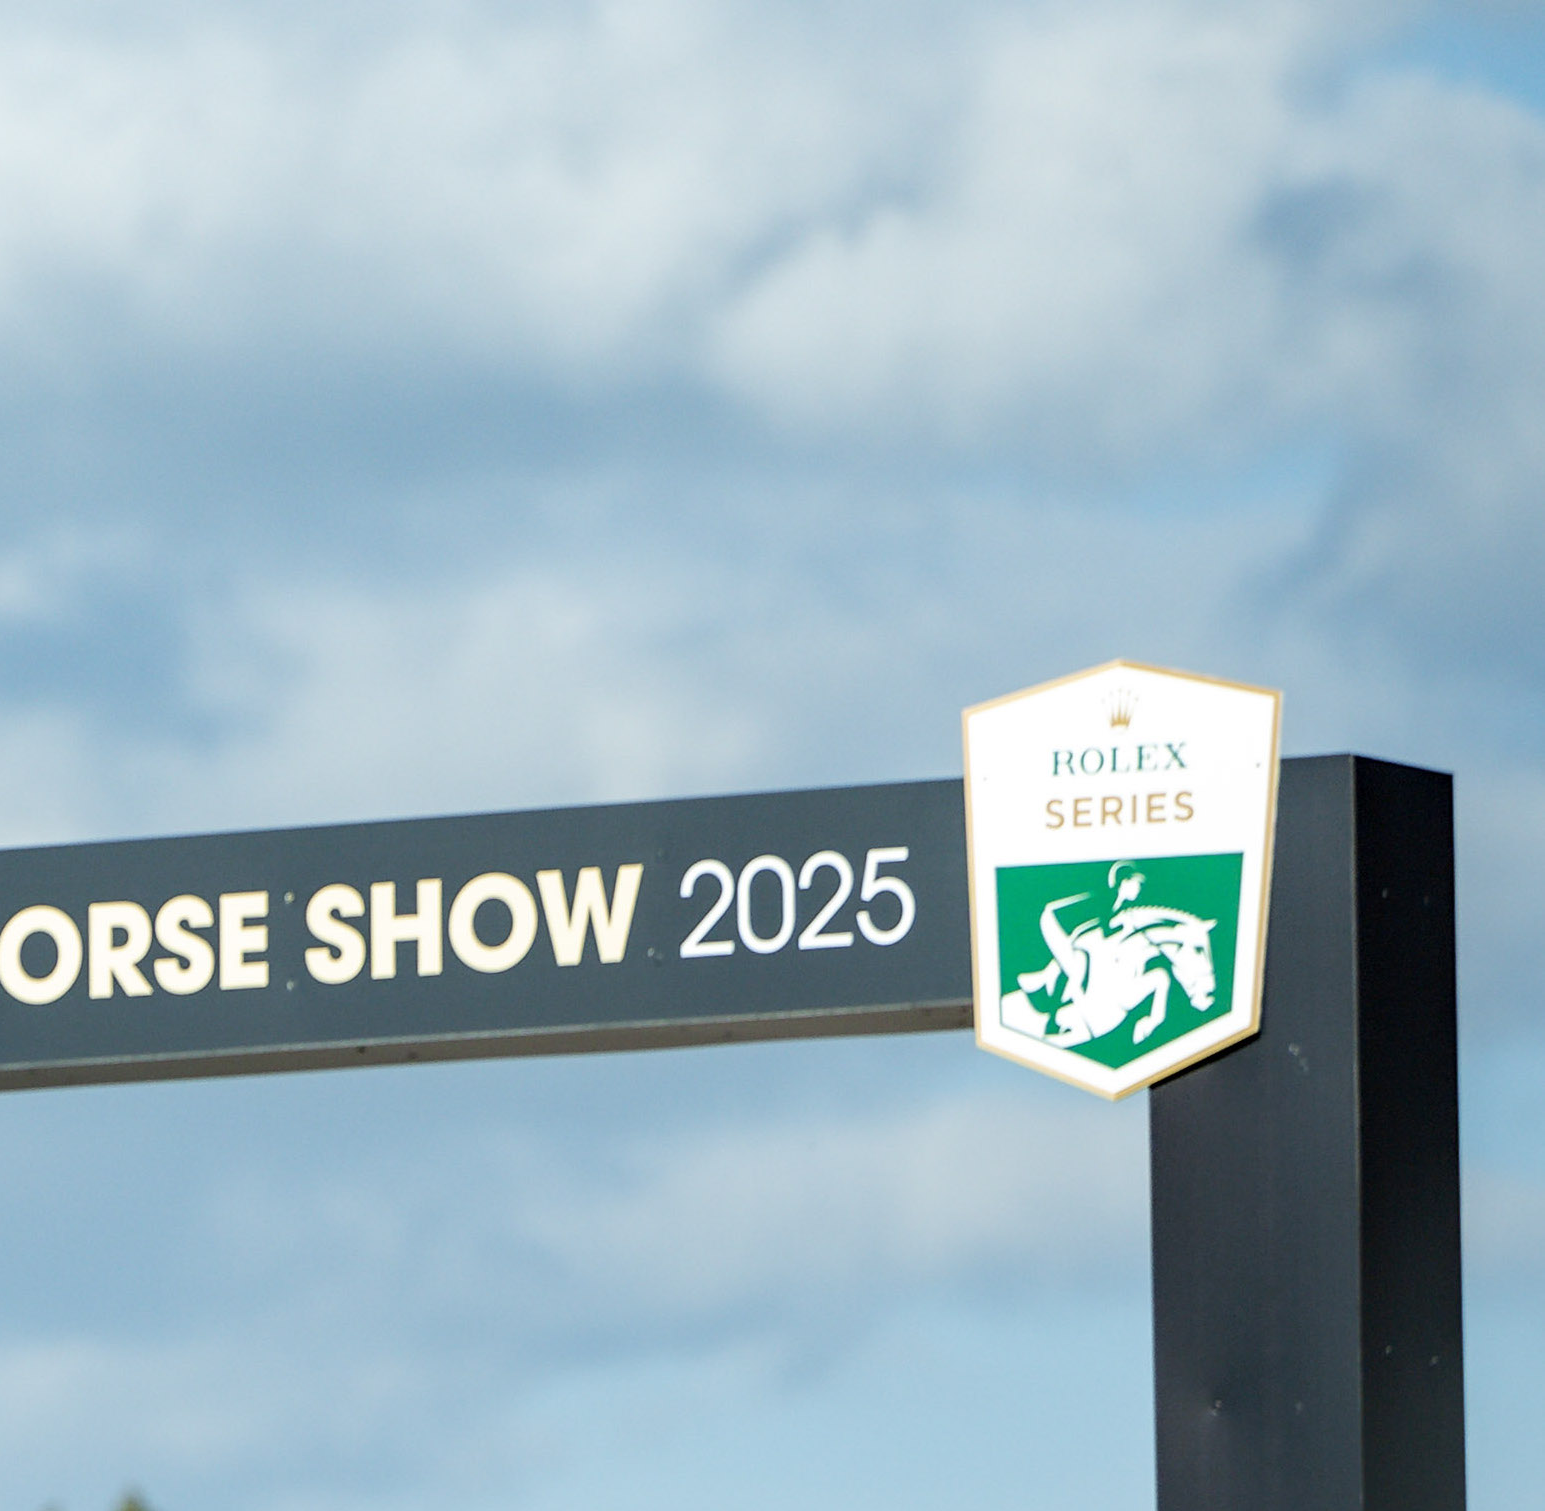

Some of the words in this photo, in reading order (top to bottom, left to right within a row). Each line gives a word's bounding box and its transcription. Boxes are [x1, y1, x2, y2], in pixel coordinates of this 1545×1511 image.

[1051, 742, 1189, 777] ROLEX
[1044, 791, 1196, 830] SERIES
[306, 862, 644, 986] SHOW
[679, 846, 915, 959] 2025
